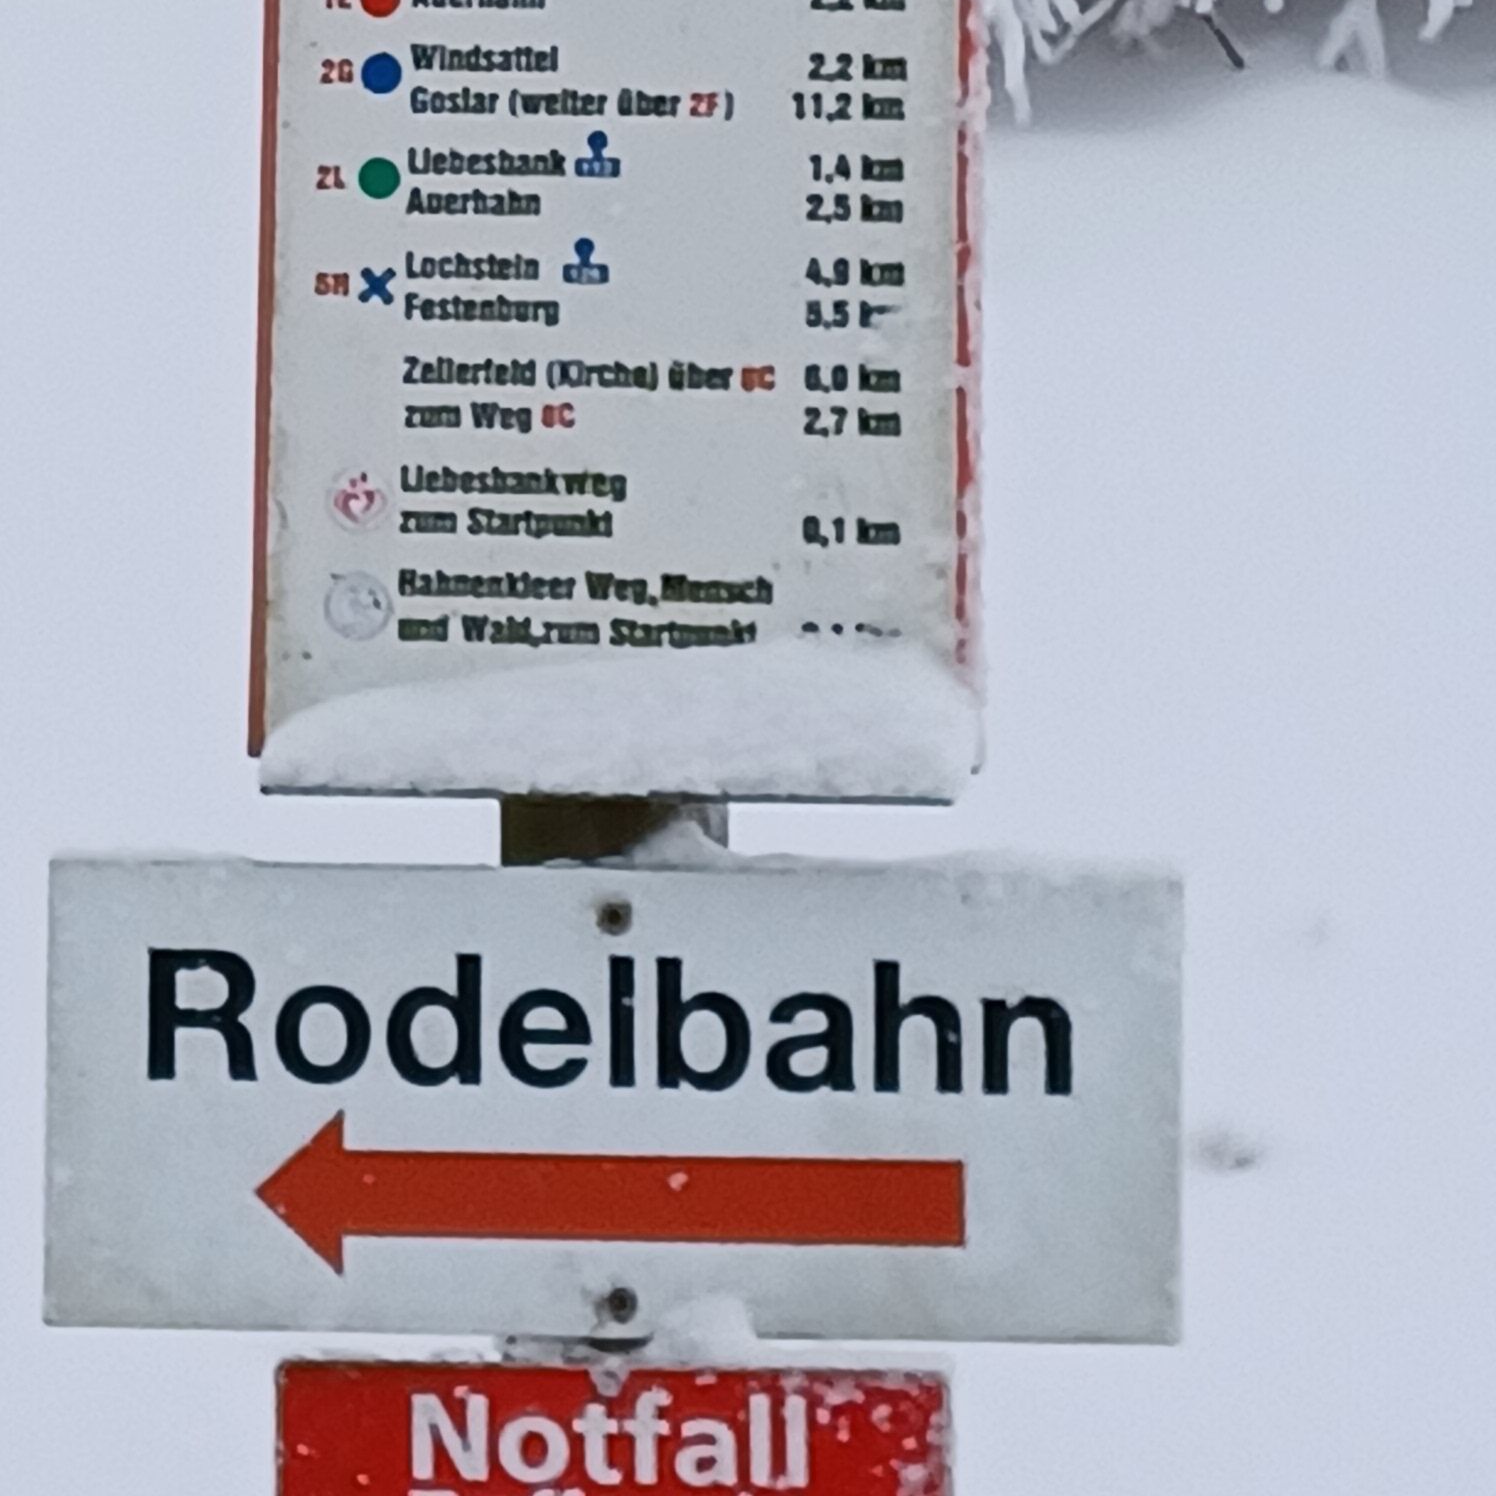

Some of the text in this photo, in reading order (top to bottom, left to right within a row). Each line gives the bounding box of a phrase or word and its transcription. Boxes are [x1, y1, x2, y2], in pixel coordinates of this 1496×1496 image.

[409, 43, 559, 73] Windsattel
[807, 52, 908, 83] 2,2 km
[409, 85, 500, 115] Goslar
[508, 87, 609, 118] (weiter
[616, 87, 682, 118] über
[791, 91, 906, 123] 11,2 km
[407, 146, 567, 177] Liebesbank
[808, 153, 905, 185] 1,4 km
[405, 186, 542, 217] Auerhahn
[805, 193, 904, 225] 2,5 km
[405, 250, 540, 281] Lochstein
[859, 258, 906, 287] km
[404, 291, 560, 328] Festenburg
[402, 355, 537, 387] Zellerfeld
[545, 359, 659, 392] (Kirche)
[667, 359, 734, 392] über
[858, 363, 902, 394] km
[404, 404, 462, 429] zum
[469, 401, 533, 435] Weg
[803, 405, 902, 439] 2,7 km
[400, 464, 628, 503] Liebesbankweg
[398, 506, 614, 540] zum Startpunkt
[856, 517, 901, 546] km
[397, 614, 451, 643] und
[608, 617, 758, 650] Startpunkt
[147, 946, 1073, 1097] Rodelbahn
[410, 1390, 810, 1488] Notfall
